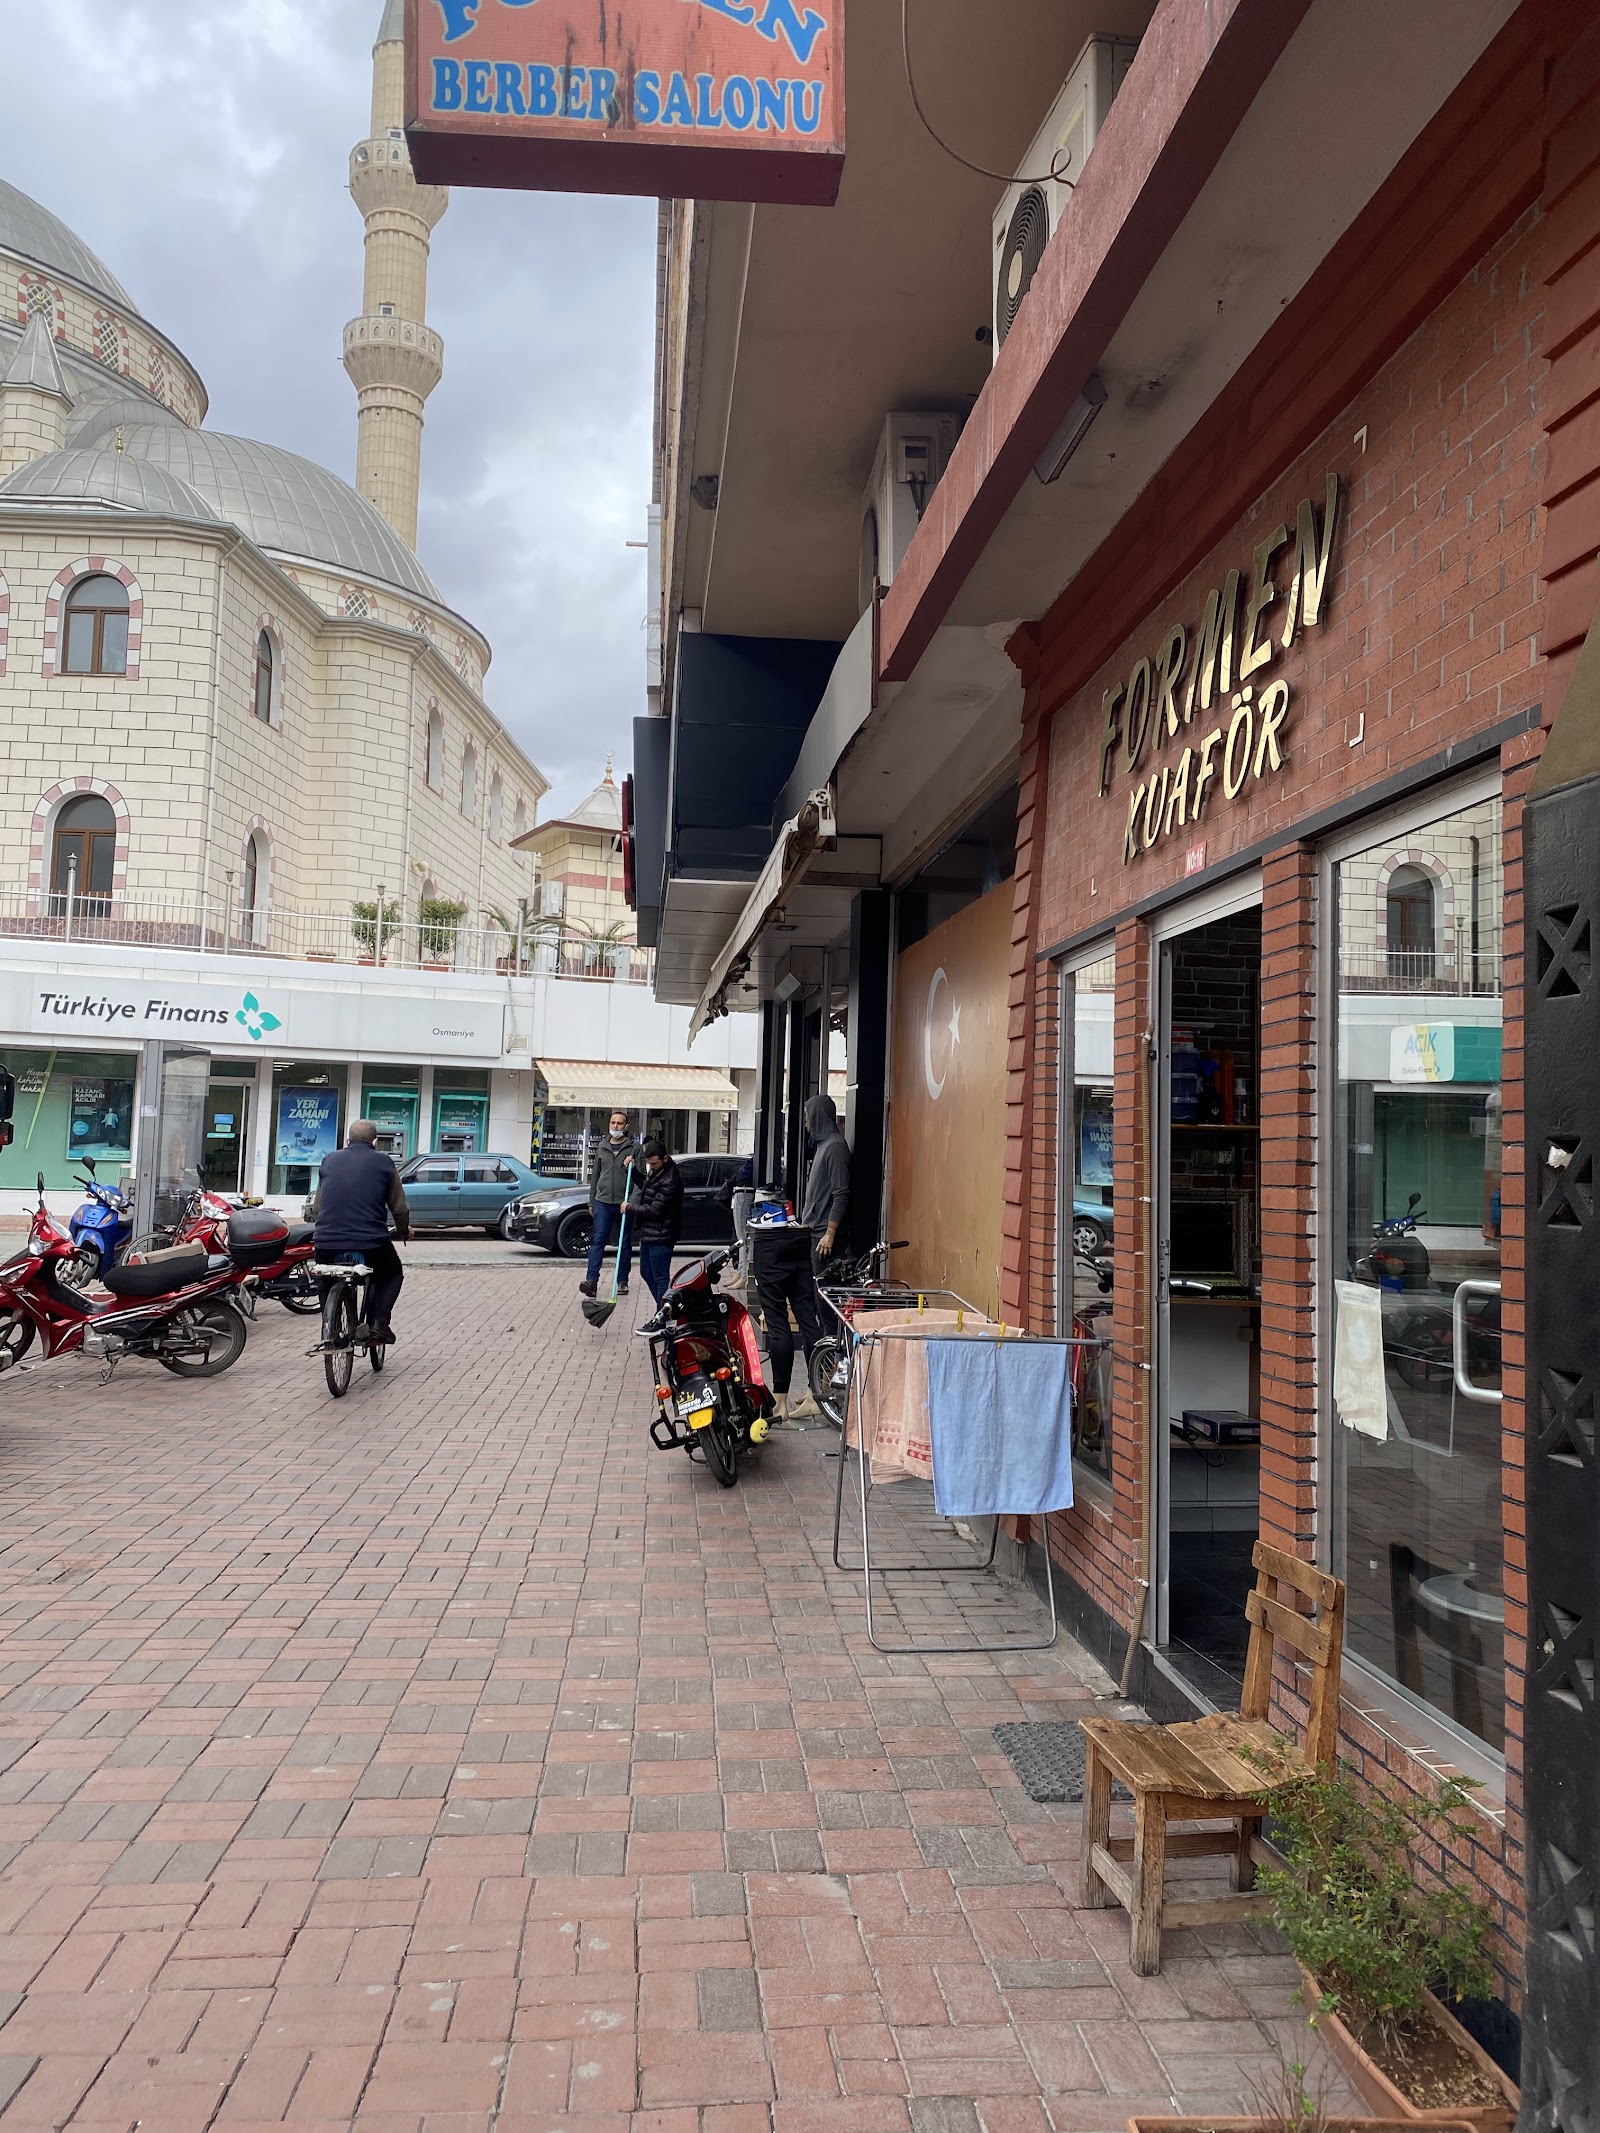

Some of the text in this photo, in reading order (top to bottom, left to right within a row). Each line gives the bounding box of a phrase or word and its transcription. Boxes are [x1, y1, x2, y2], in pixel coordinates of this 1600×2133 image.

[432, 57, 824, 134] BERBER SALONU
[1098, 472, 1339, 798] FORMEN
[1121, 679, 1290, 865] KUAFÖR
[40, 993, 229, 1024] Türkiye Finans
[432, 1027, 475, 1038] Osmaniye
[1405, 1032, 1438, 1058] AÇIK
[288, 1108, 330, 1119] ZAMANI
[297, 1099, 320, 1109] YERİ
[302, 1119, 323, 1129] YOK
